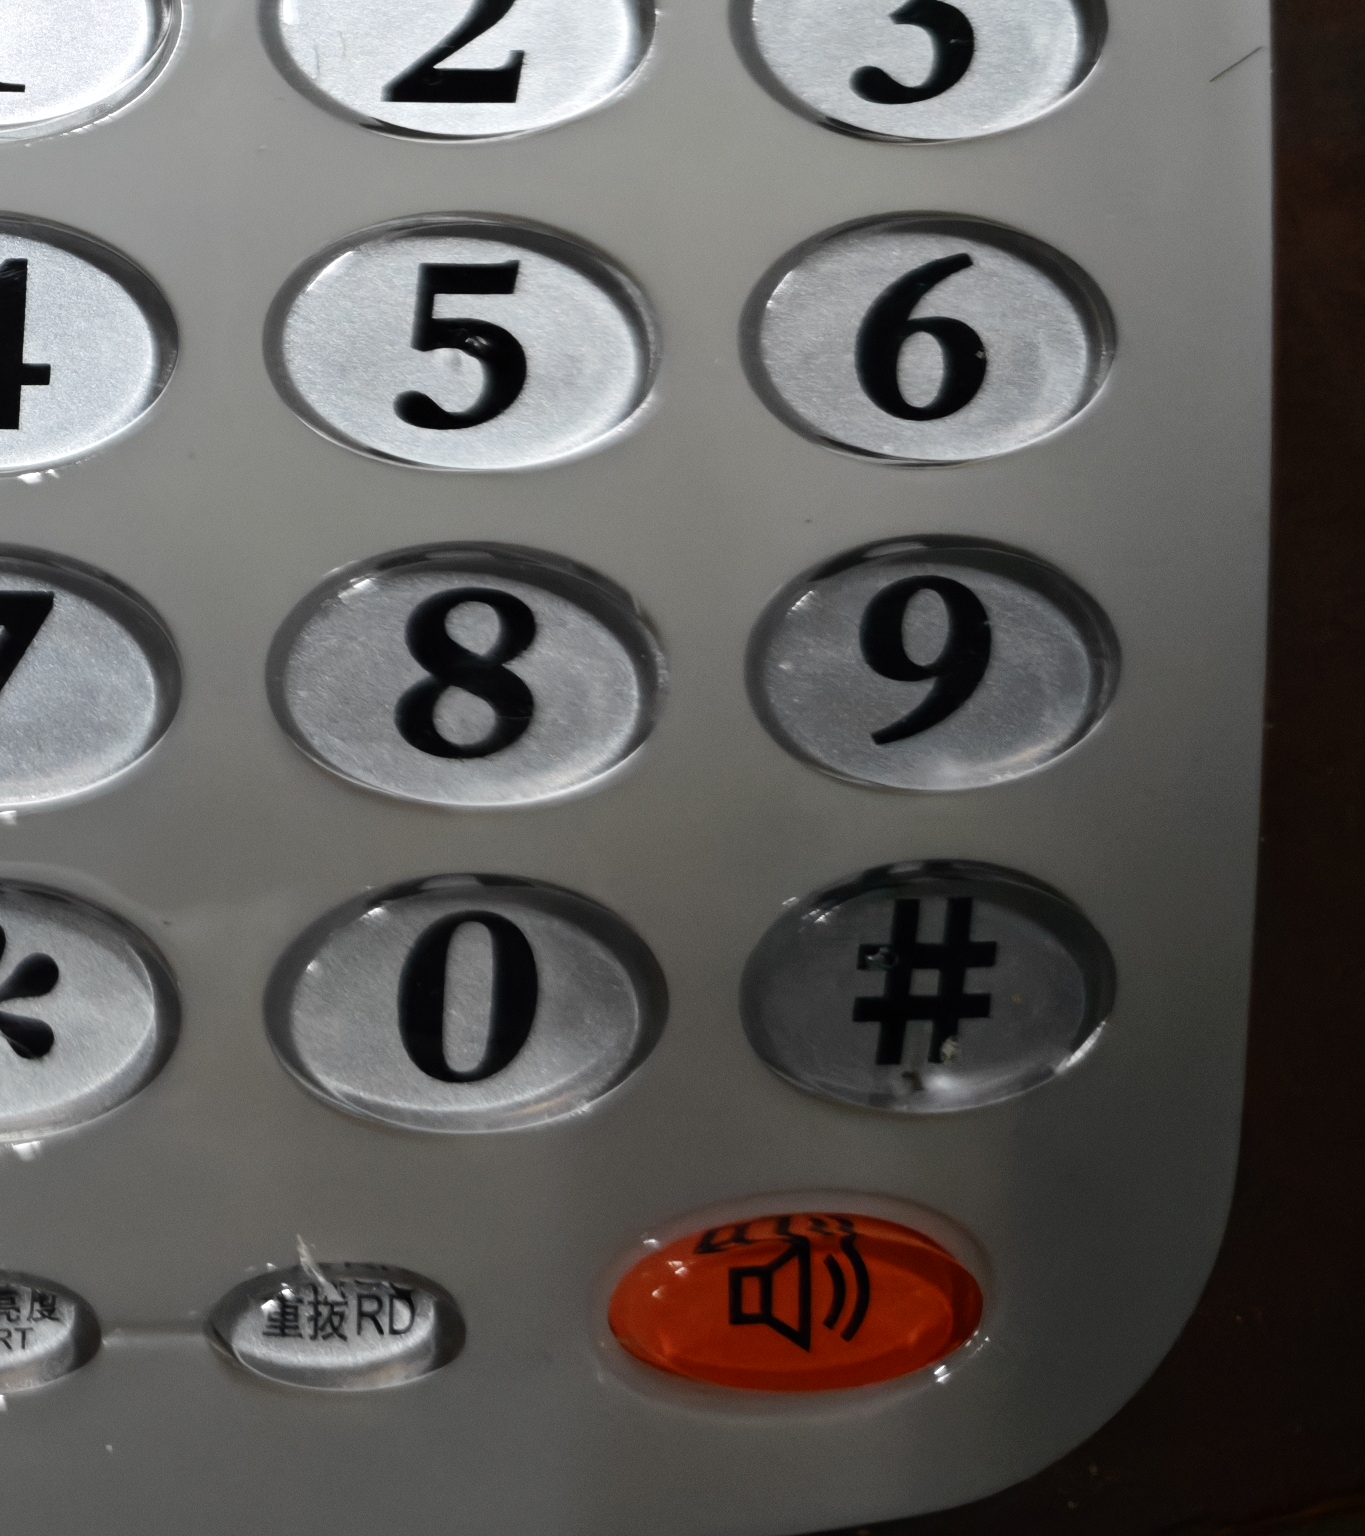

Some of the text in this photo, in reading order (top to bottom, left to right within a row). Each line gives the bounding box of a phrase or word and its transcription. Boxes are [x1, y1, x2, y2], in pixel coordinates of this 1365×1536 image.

[393, 259, 528, 432] 5
[854, 252, 989, 423] 6
[393, 585, 536, 761] 8
[858, 573, 994, 747] 9
[396, 910, 539, 1085] 0
